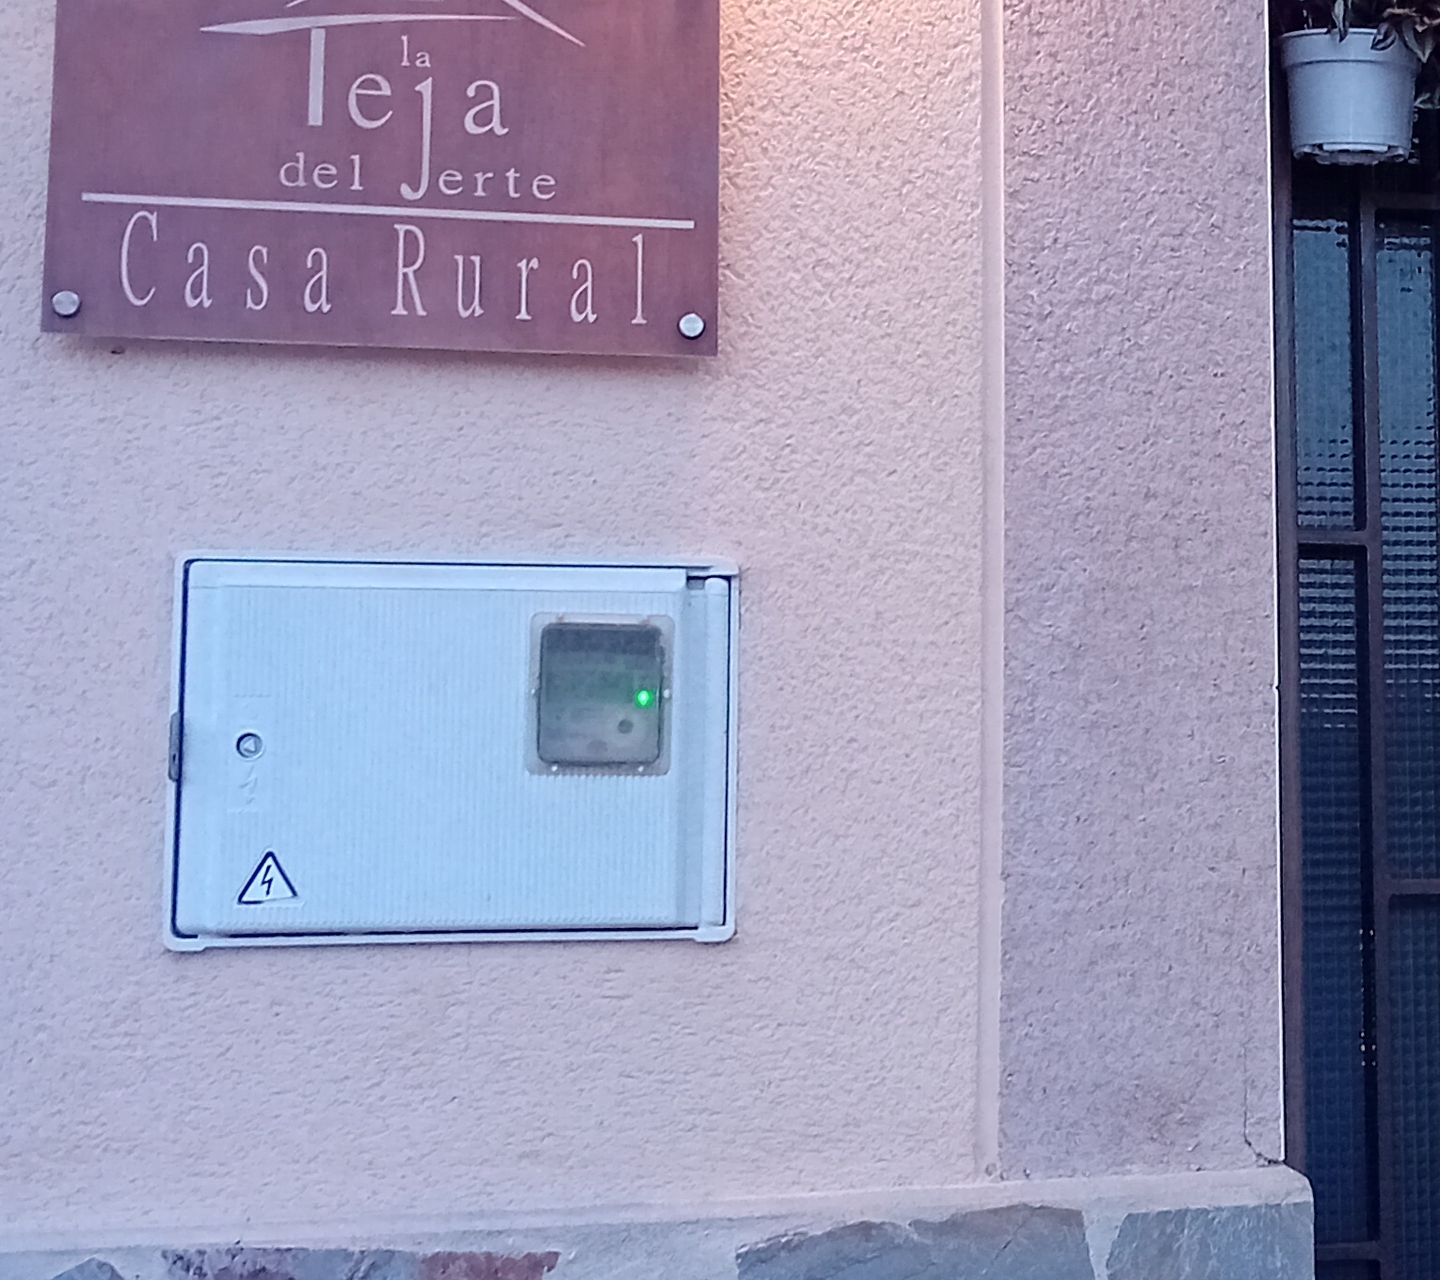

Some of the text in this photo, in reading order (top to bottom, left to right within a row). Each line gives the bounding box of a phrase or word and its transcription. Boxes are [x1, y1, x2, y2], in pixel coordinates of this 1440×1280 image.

[400, 35, 431, 68] la
[279, 153, 364, 191] del
[120, 210, 647, 325] Casa Rural
